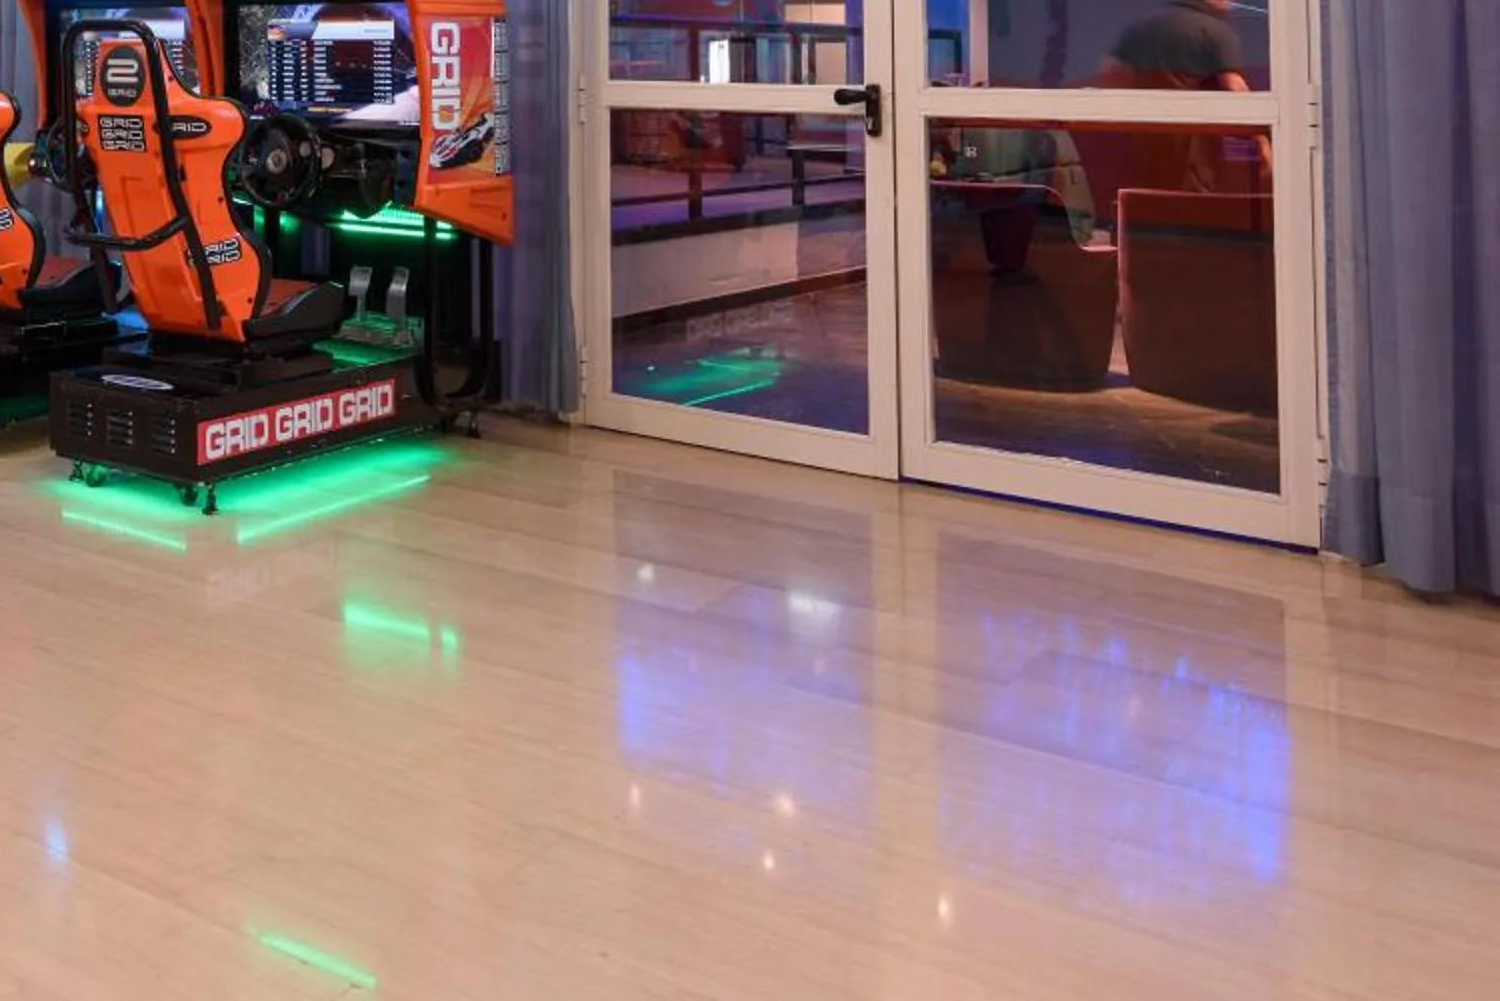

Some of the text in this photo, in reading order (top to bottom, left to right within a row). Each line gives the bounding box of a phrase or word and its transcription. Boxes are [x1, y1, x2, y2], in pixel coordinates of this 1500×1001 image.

[107, 59, 139, 83] 2
[431, 21, 461, 131] GRID
[100, 116, 143, 128] GRID
[171, 122, 207, 132] RID
[205, 384, 393, 460] GRID GRID GRID
